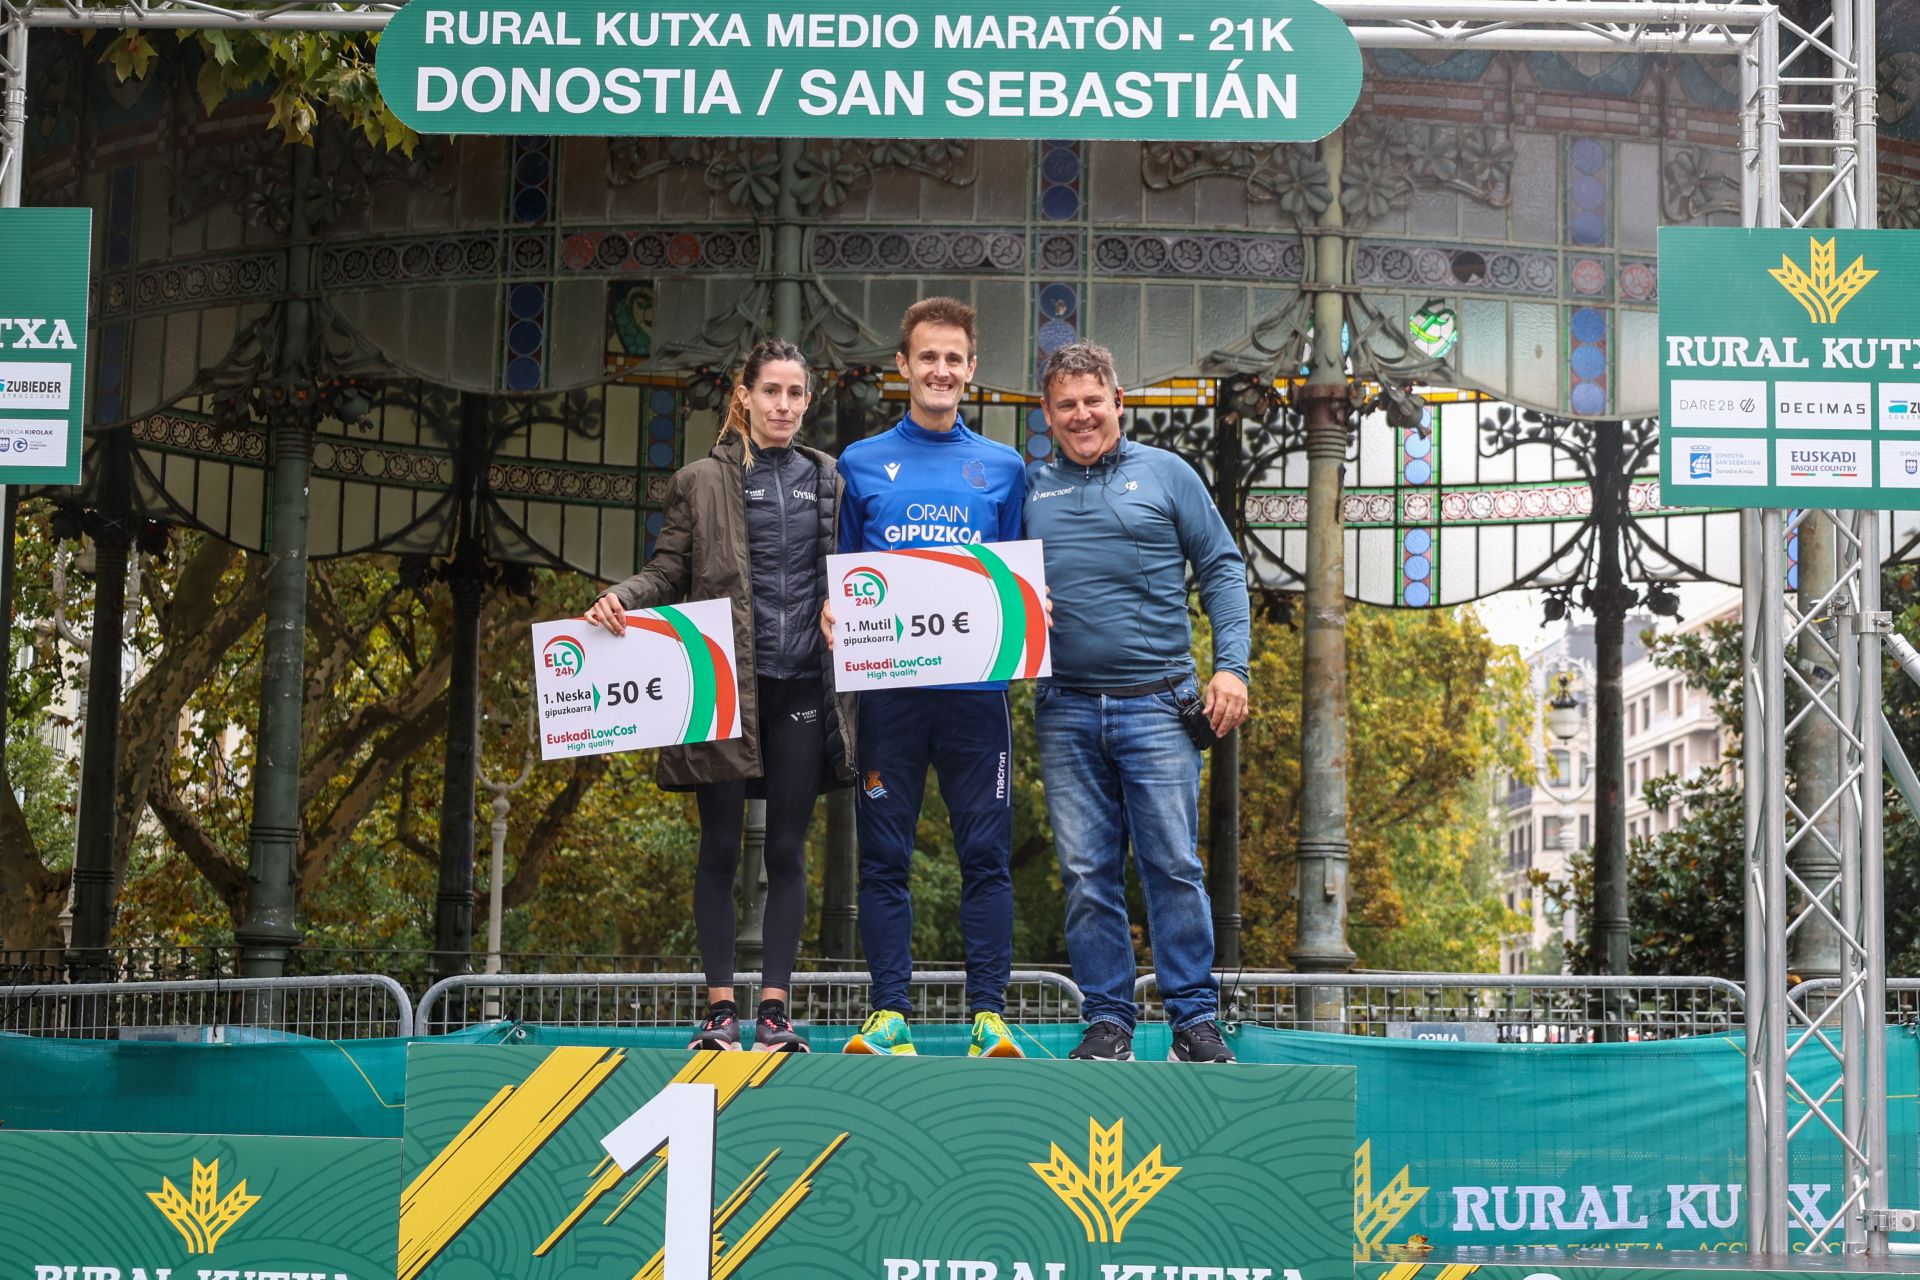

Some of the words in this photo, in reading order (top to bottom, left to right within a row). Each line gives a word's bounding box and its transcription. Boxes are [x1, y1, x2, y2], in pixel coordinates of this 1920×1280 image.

[425, 10, 581, 46] RURAL
[596, 12, 752, 48] KUTXA
[766, 14, 919, 49] MEDIO
[934, 5, 1163, 51] MARATÓN
[1178, 33, 1195, 42] -
[1208, 17, 1294, 52] 21K
[416, 66, 742, 115] DONOSTIA
[756, 69, 784, 117] /
[798, 69, 925, 117] SAN
[945, 58, 1298, 120] SEBASTIÁN
[1666, 335, 1810, 368] RURAL
[1822, 338, 1920, 370] KUT
[6, 381, 61, 393] ZUBIEDER
[1780, 402, 1866, 415] DECIMAS
[1791, 451, 1857, 463] EUSKADI
[906, 503, 969, 524] ORAIN
[884, 524, 982, 545] GIPUZKOA
[844, 581, 875, 598] ELC
[855, 597, 877, 607] 24h
[845, 621, 856, 633] 1.
[859, 618, 892, 632] Mutil
[911, 613, 945, 638] 50
[952, 611, 971, 634] €
[843, 635, 894, 646] gipuzkoarra
[544, 651, 573, 668] ELC
[845, 655, 943, 672] EuskadiLowCost
[555, 667, 575, 677] 24h
[867, 669, 887, 680] High
[889, 668, 918, 678] quality
[544, 693, 555, 704] 1.
[556, 689, 592, 702] Neska
[607, 680, 639, 706] 50
[645, 677, 664, 700] €
[544, 704, 592, 719] gipuzkoarra
[546, 723, 638, 745] EuskadiLowCost
[567, 742, 587, 752] High
[588, 738, 615, 750] quality
[995, 751, 1007, 800] macron
[600, 1083, 714, 1280] 1
[1452, 1185, 1648, 1231] RURAL
